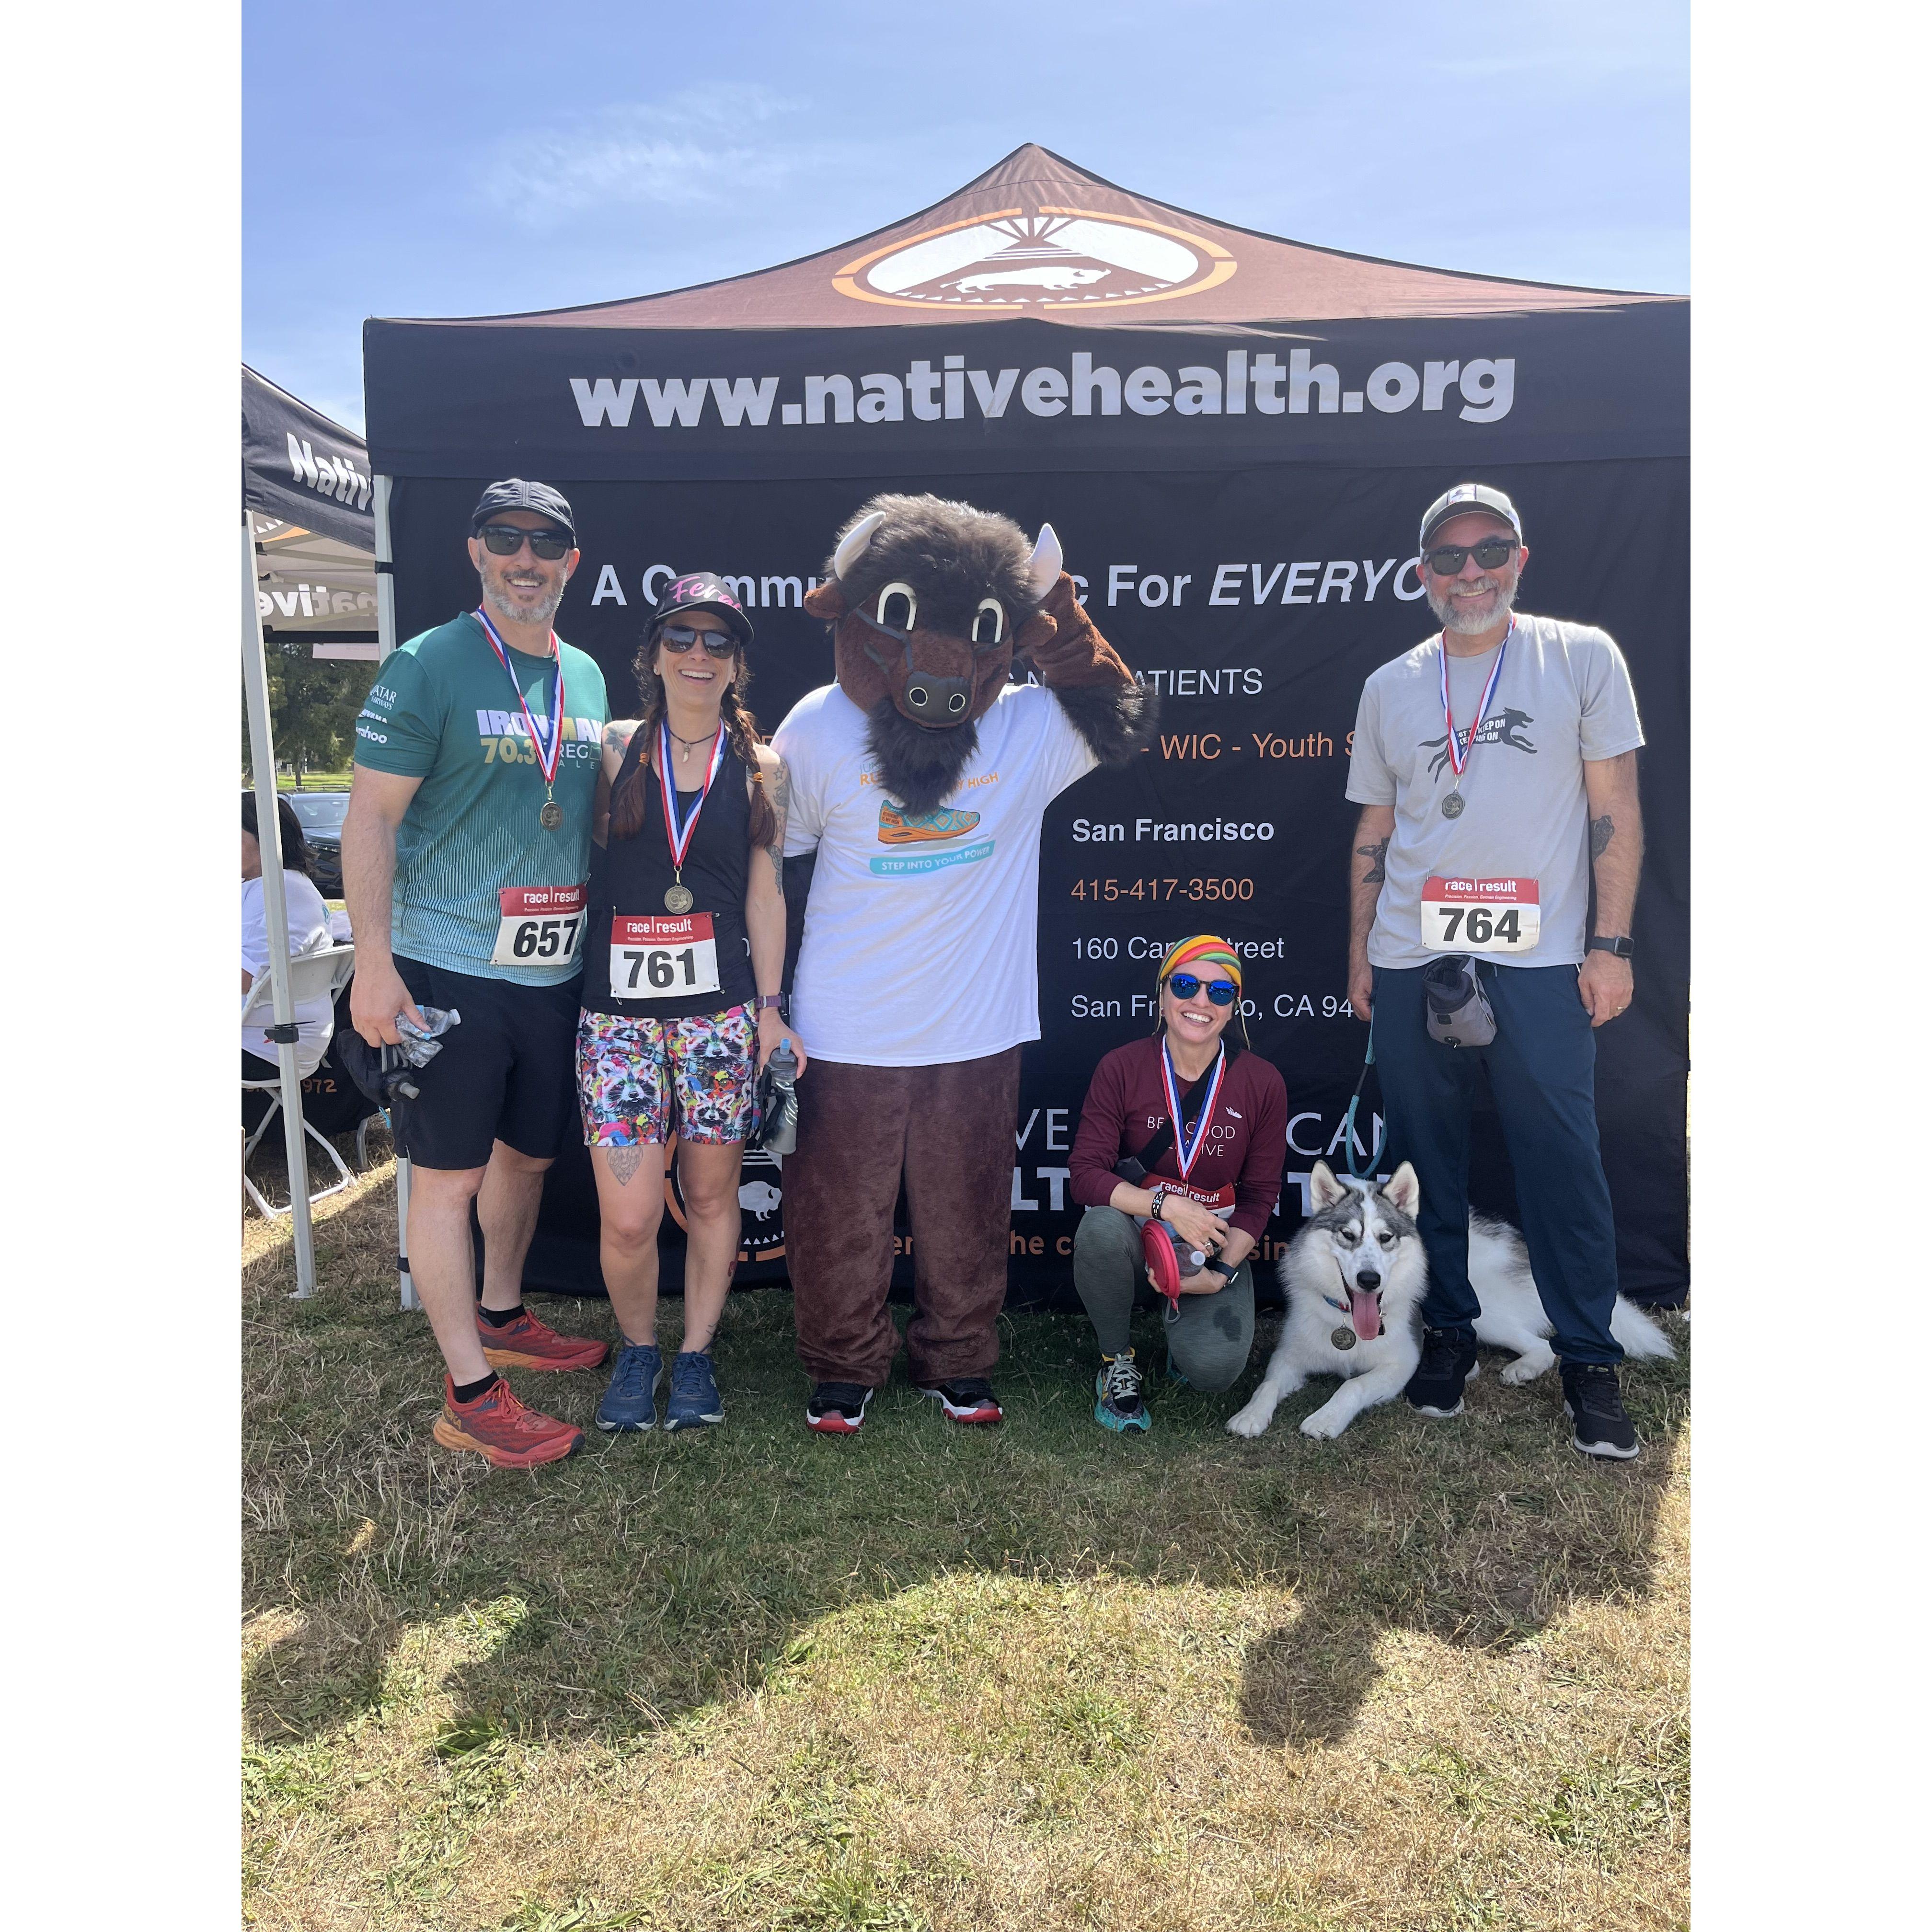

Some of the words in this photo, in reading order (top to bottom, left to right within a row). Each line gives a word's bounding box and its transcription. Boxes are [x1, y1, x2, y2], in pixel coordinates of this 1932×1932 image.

[569, 348, 1515, 426] www.nativehealth.org
[287, 432, 374, 513] Nativ
[591, 564, 627, 606] A
[1107, 565, 1192, 608] For
[1208, 557, 1426, 606] EVERYO
[370, 685, 397, 703] ATAR
[1135, 668, 1263, 696] ATIENTS
[1487, 731, 1498, 741] ON
[1495, 718, 1506, 729] ON
[481, 737, 537, 765] 70.3
[1160, 734, 1221, 759] WIC
[1252, 732, 1333, 758] Youth
[968, 771, 999, 789] HIGH
[1072, 818, 1124, 842] San
[1135, 817, 1275, 841] Francisco
[882, 862, 905, 871] STEP
[908, 860, 932, 869] INTO
[935, 853, 963, 867] YOUR
[965, 846, 990, 859] POWER
[1071, 878, 1254, 901] 415-417-3500
[513, 918, 579, 957] 657
[1439, 908, 1521, 943] 764
[1072, 937, 1118, 959] 160
[624, 948, 696, 988] 761
[1071, 995, 1120, 1017] San
[1274, 994, 1313, 1017] CA
[302, 1078, 337, 1094] 972
[1147, 1116, 1165, 1129] BE
